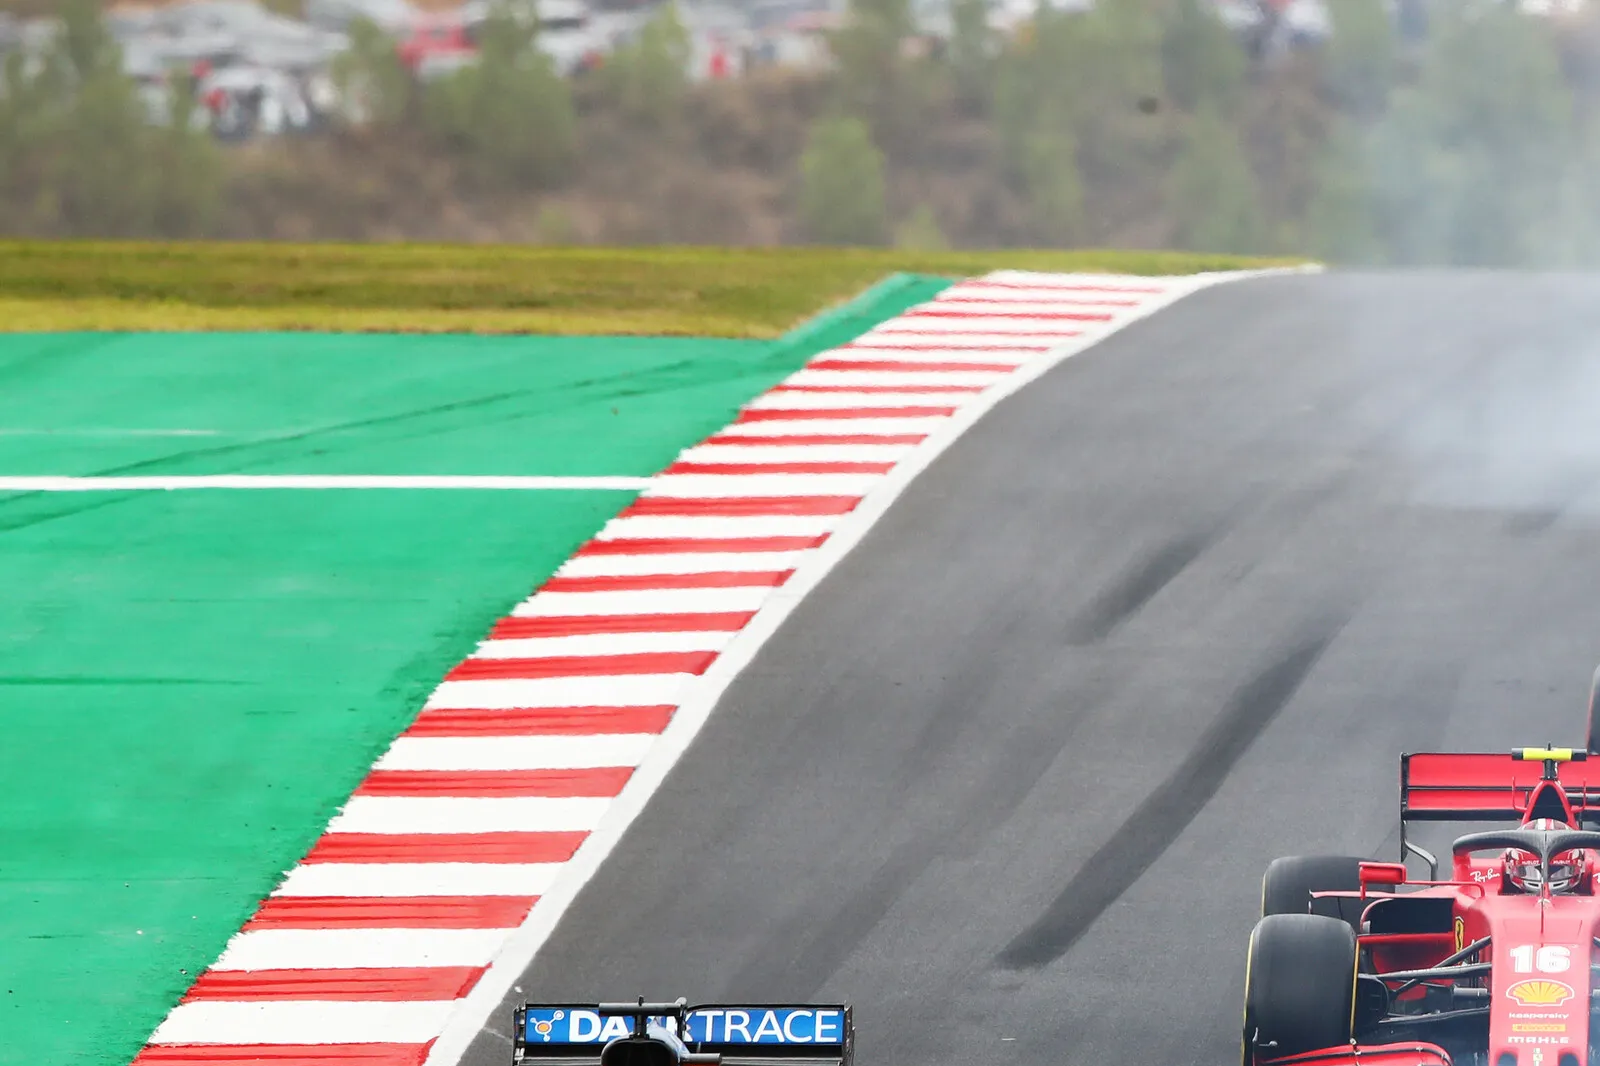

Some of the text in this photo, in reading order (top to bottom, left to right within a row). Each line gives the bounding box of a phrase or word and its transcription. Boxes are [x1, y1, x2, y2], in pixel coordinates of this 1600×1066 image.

[1470, 868, 1500, 883] Ray-Ban
[1510, 945, 1570, 973] 16
[568, 1010, 837, 1043] DAKTRACE
[1508, 1036, 1569, 1044] MAHLE
